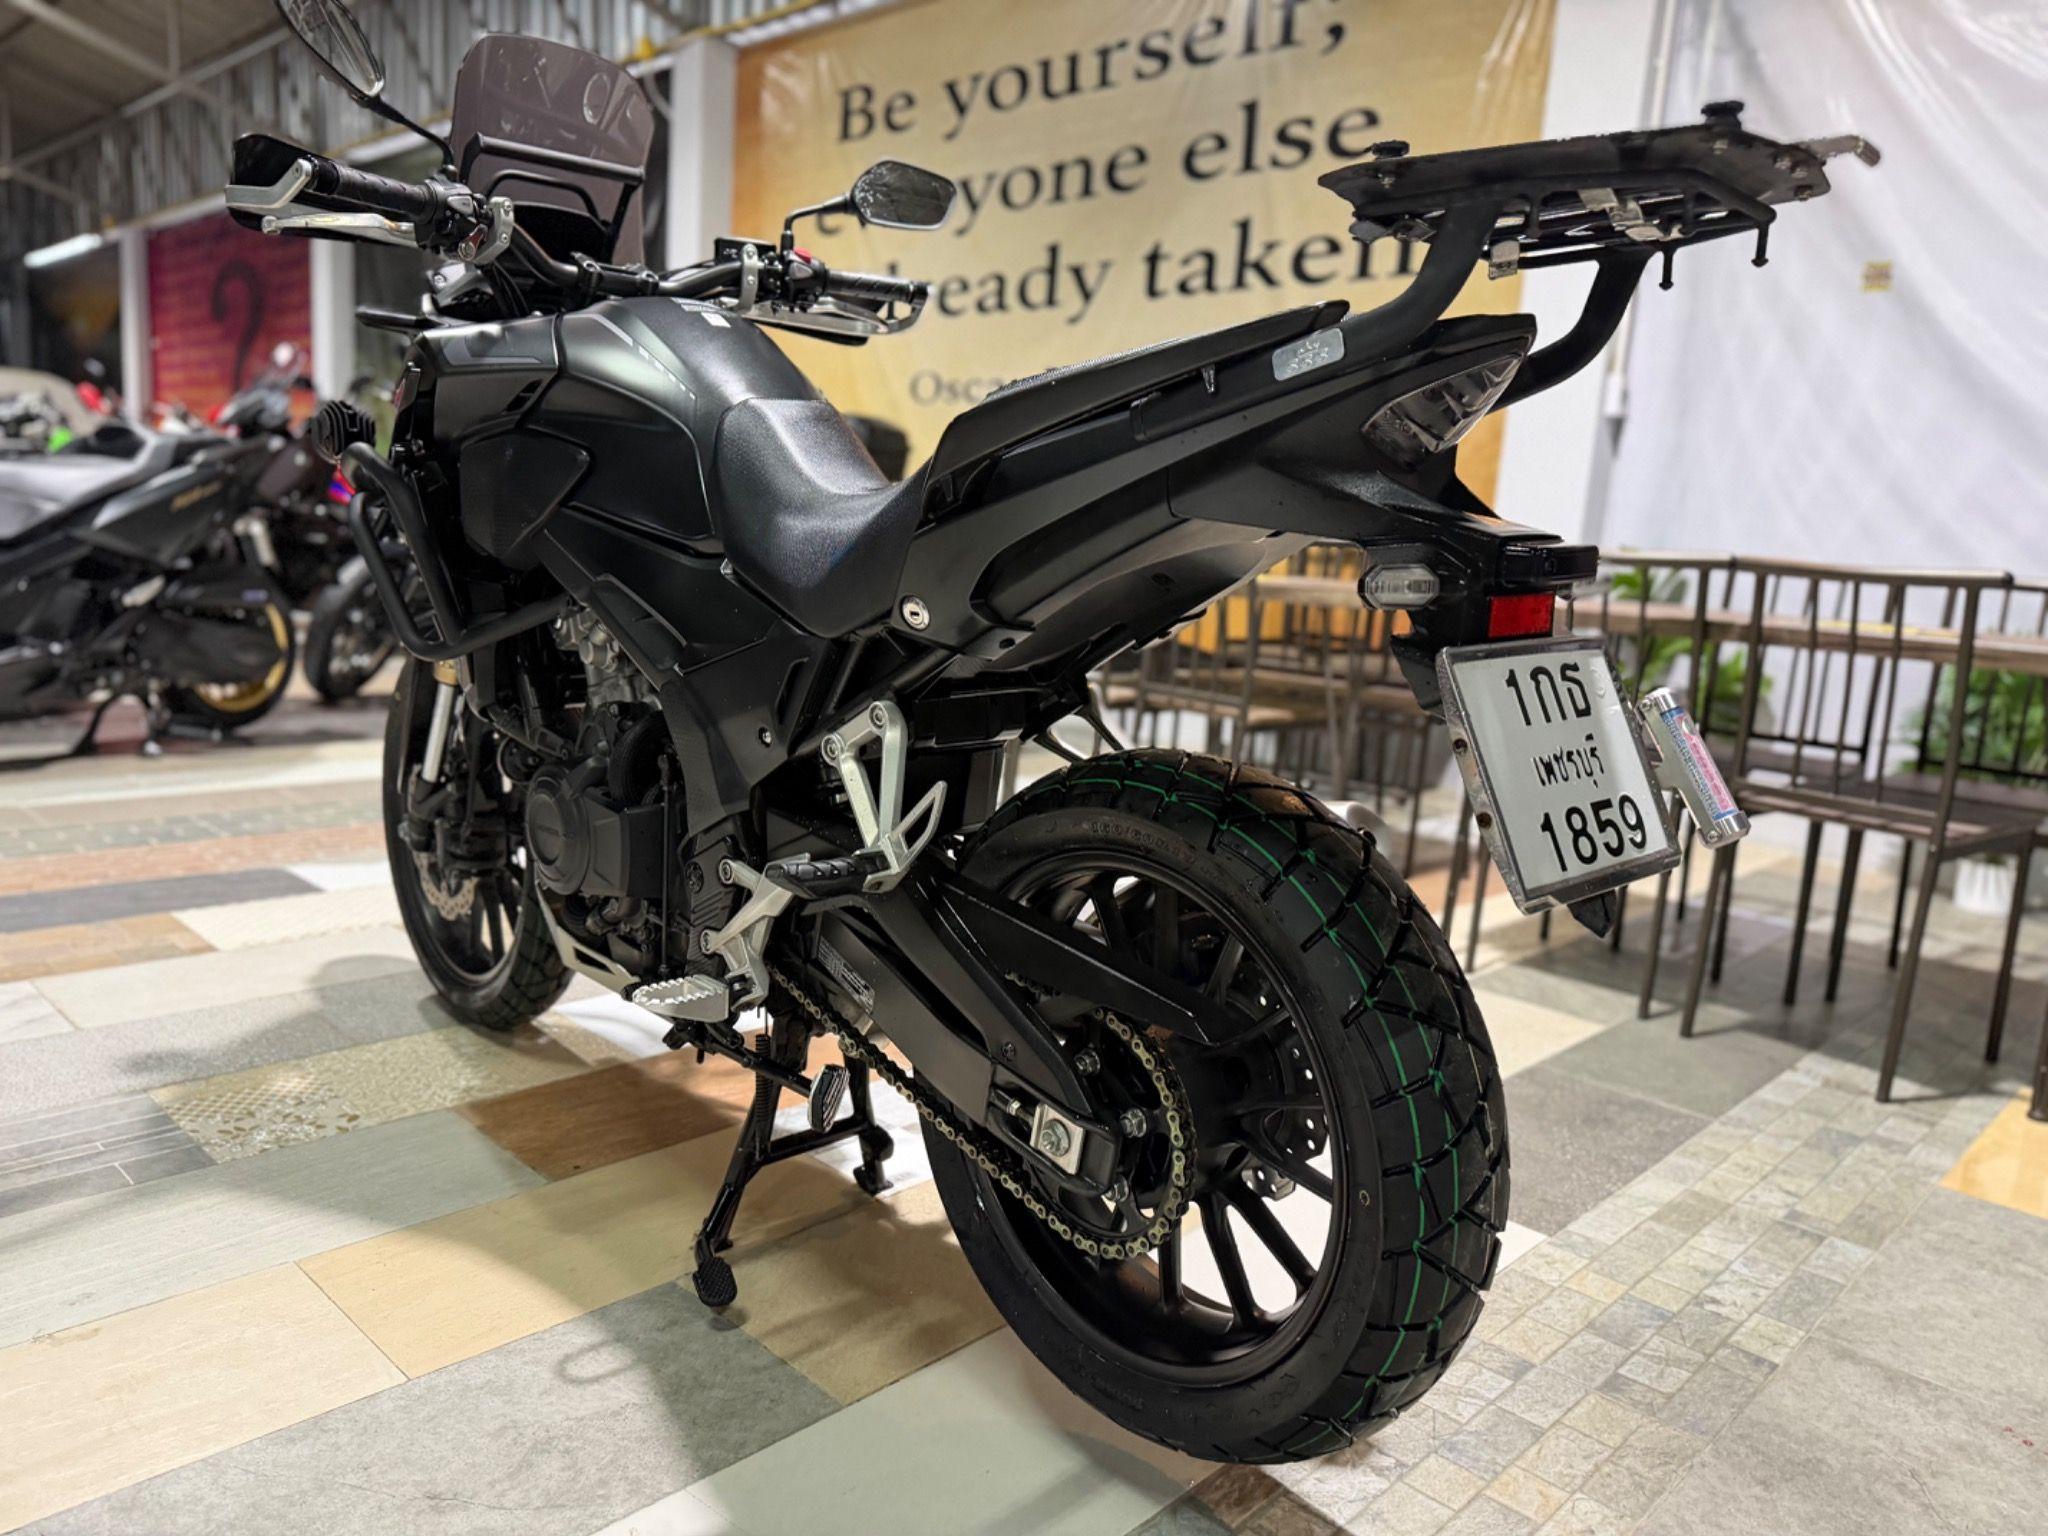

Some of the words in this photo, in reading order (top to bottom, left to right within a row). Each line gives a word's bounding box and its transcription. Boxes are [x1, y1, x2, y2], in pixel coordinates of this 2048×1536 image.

[838, 83, 916, 143] Be
[816, 143, 1149, 238] yone
[1182, 99, 1380, 181] else
[1505, 662, 1592, 727] 1กธ
[1532, 732, 1604, 788] เพชรบุรี
[1540, 794, 1648, 873] 1859
